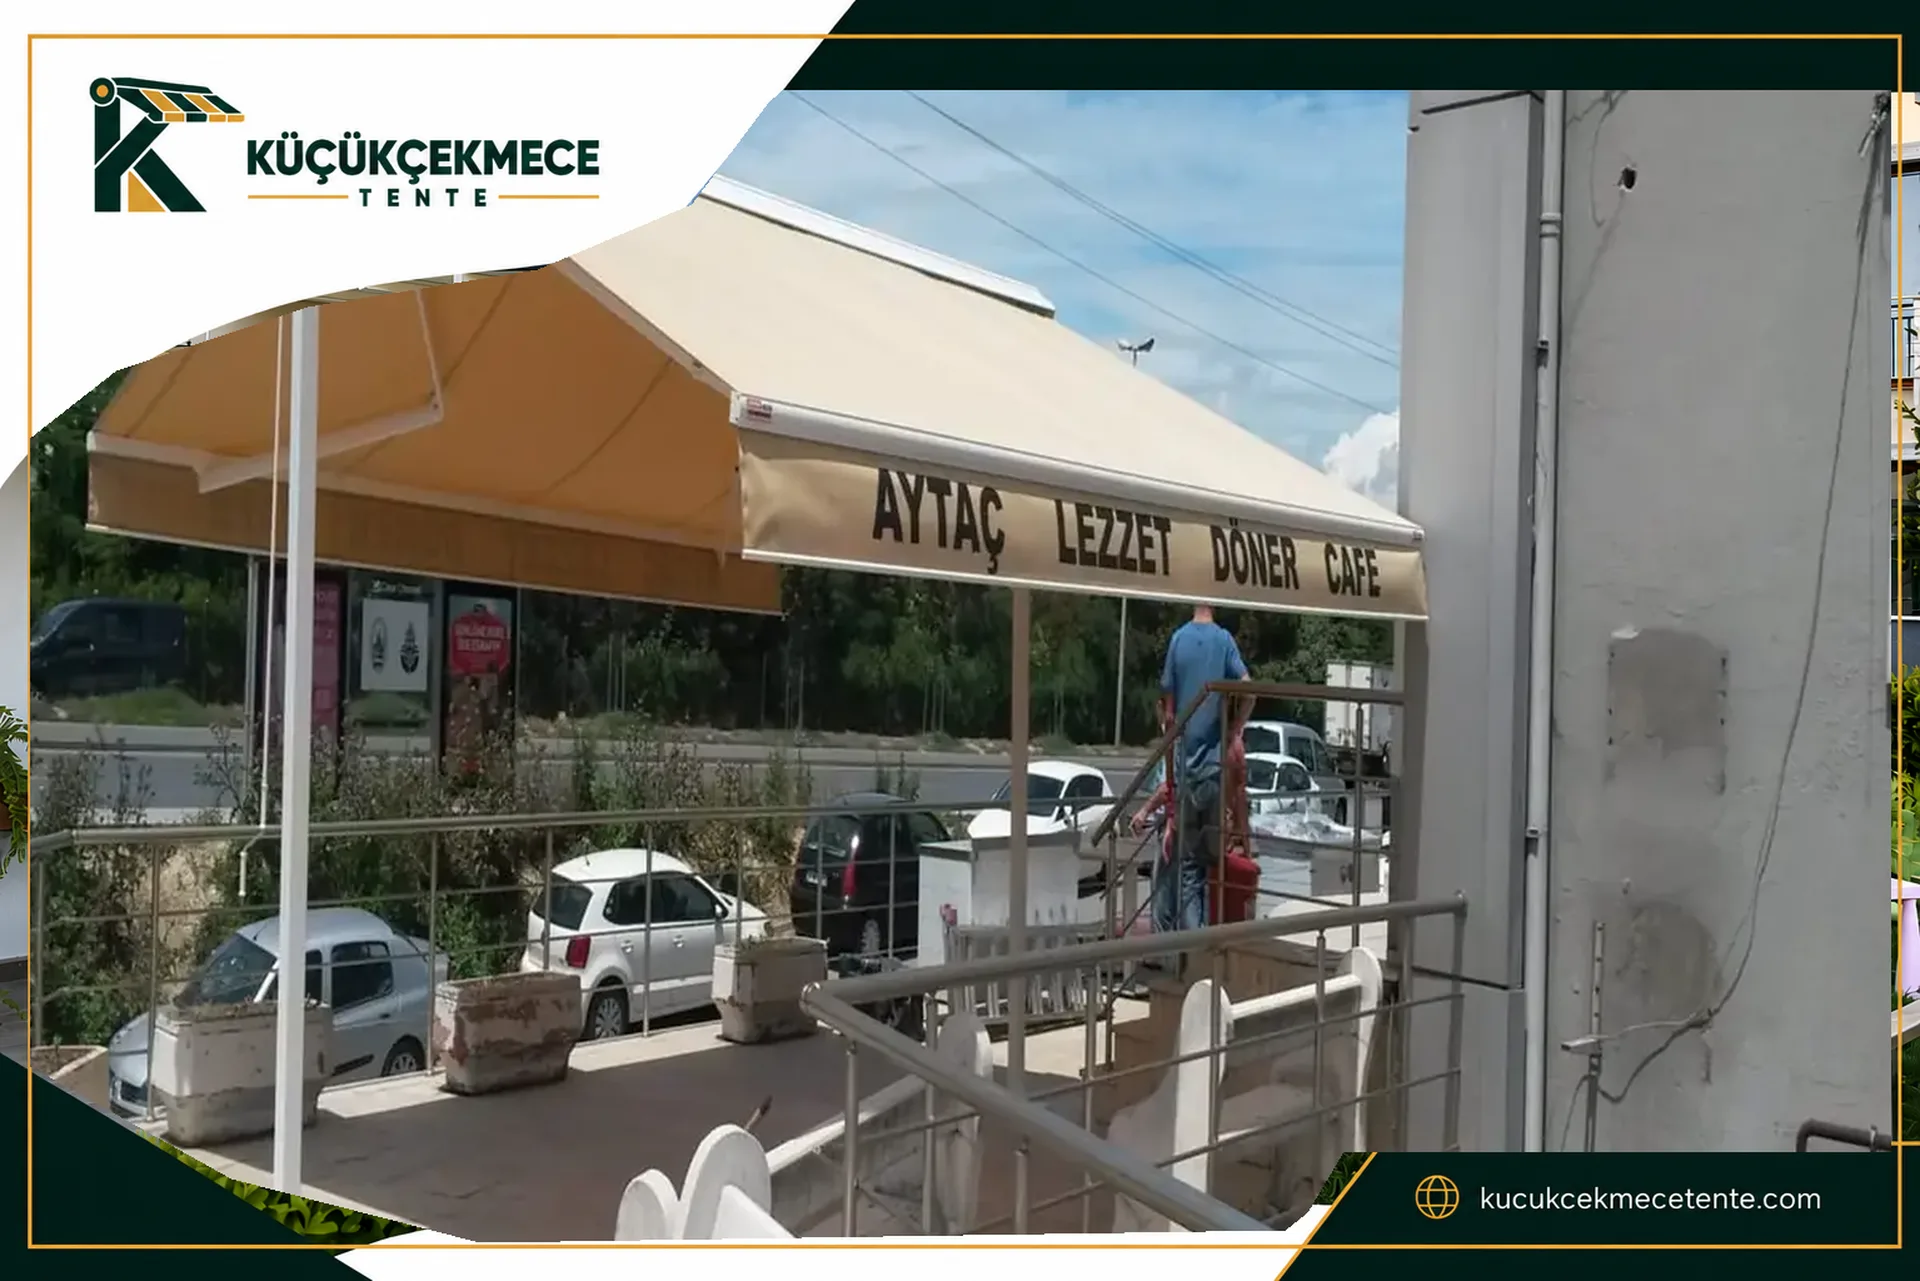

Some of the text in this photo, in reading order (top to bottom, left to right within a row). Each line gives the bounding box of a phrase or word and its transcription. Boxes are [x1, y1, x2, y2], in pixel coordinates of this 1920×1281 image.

[873, 467, 1381, 597] AYTAÇ LEZZET DÖNER CAFE
